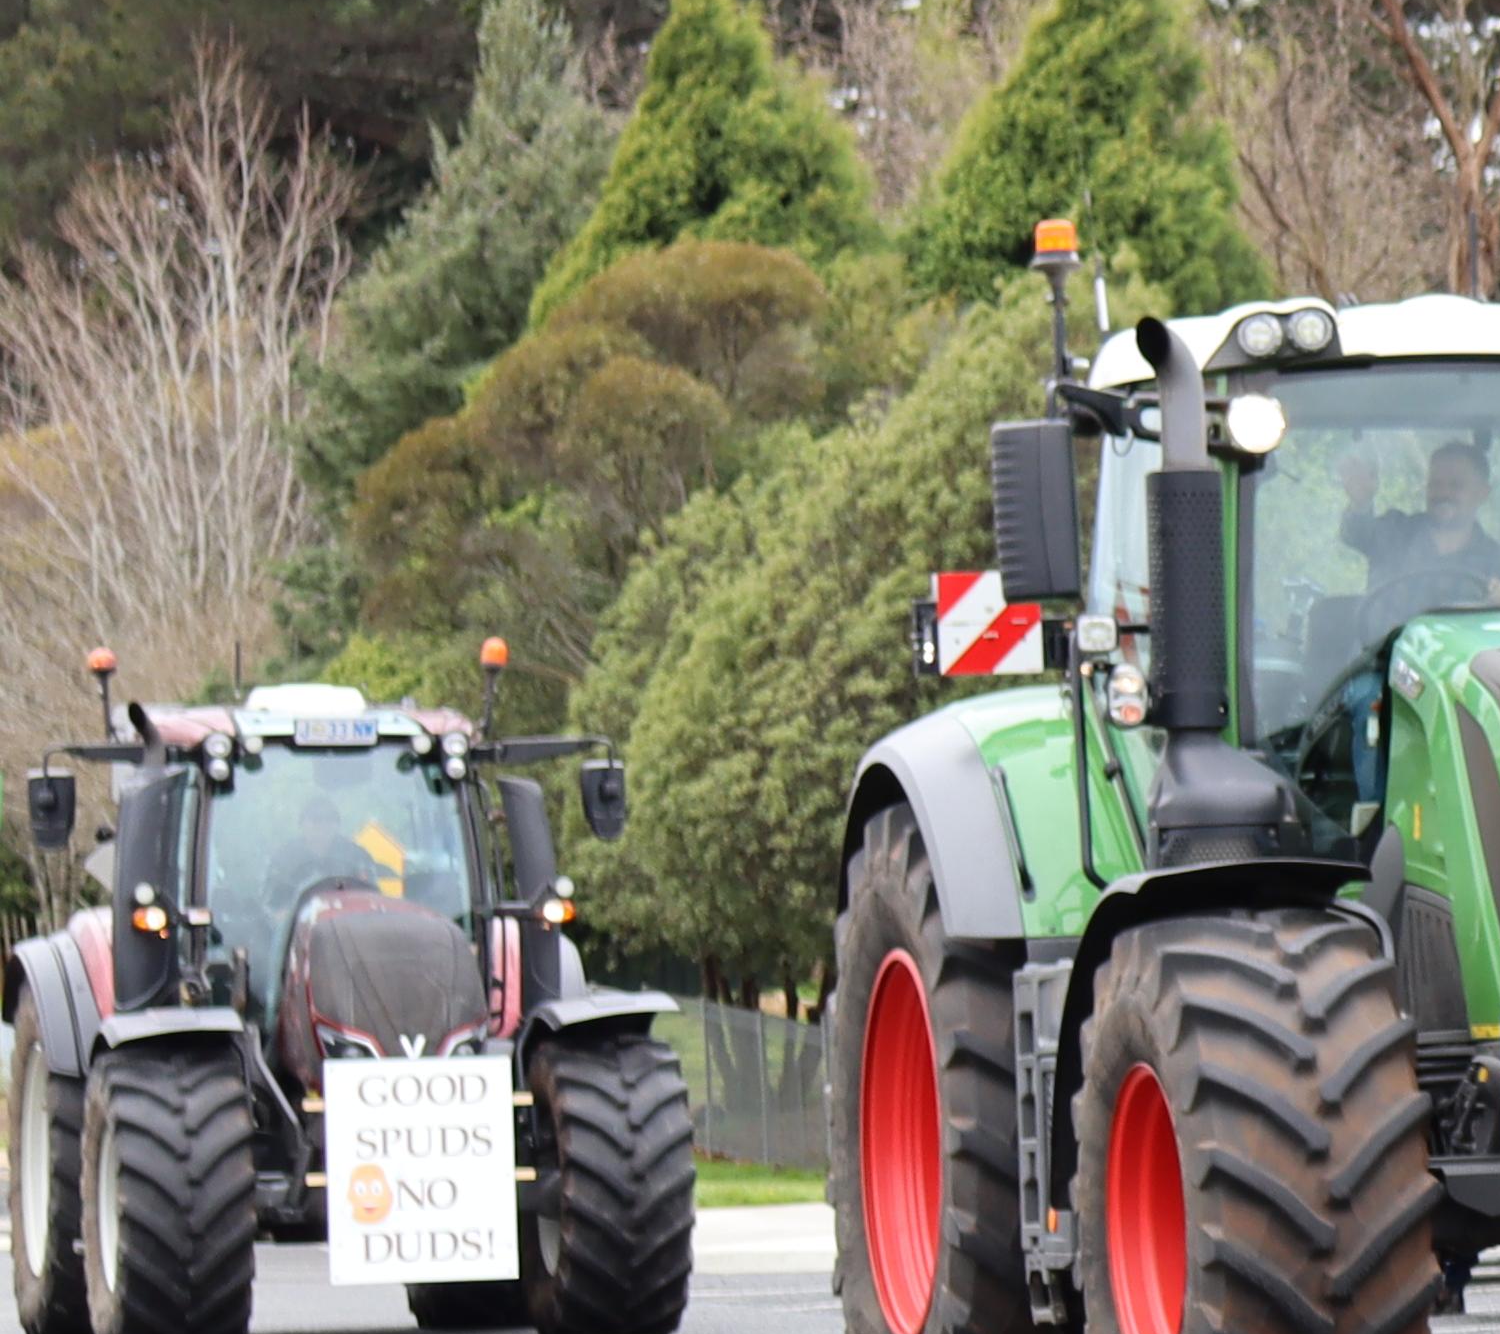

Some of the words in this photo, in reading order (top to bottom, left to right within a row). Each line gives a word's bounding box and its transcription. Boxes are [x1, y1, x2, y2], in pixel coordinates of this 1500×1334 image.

[357, 1073, 488, 1107] GOOD
[356, 1124, 493, 1161] SPUDS
[396, 1177, 458, 1210] NO
[363, 1229, 495, 1264] DUDS!
